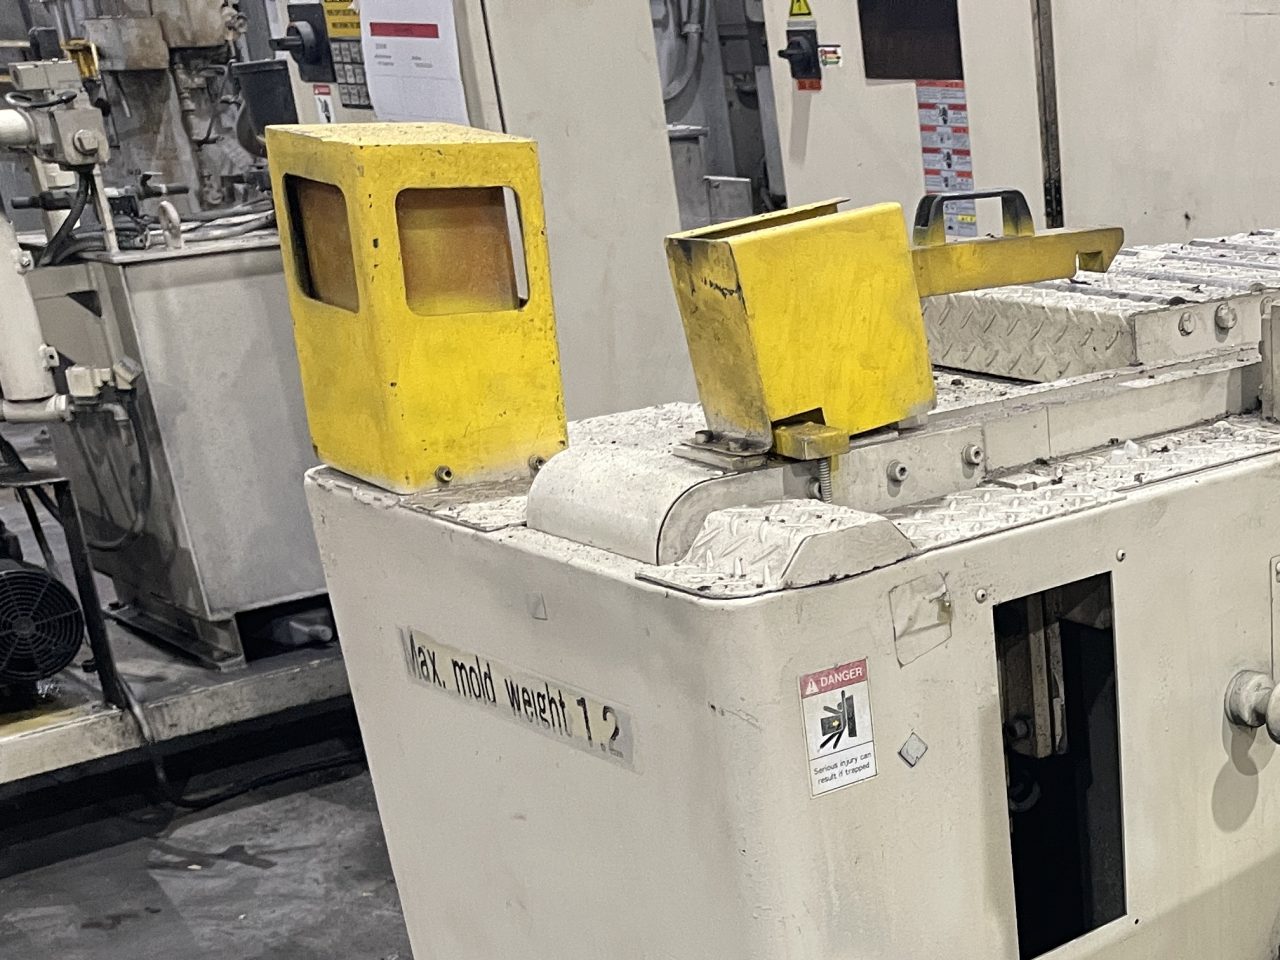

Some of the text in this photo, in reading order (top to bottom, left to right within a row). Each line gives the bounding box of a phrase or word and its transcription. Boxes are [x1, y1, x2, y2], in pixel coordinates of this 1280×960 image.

[820, 667, 863, 687] DANGER
[452, 655, 497, 704] mold
[504, 676, 573, 737] weight
[814, 752, 872, 775] Serious injury can
[817, 773, 837, 785] result
[845, 762, 870, 776] trapped
